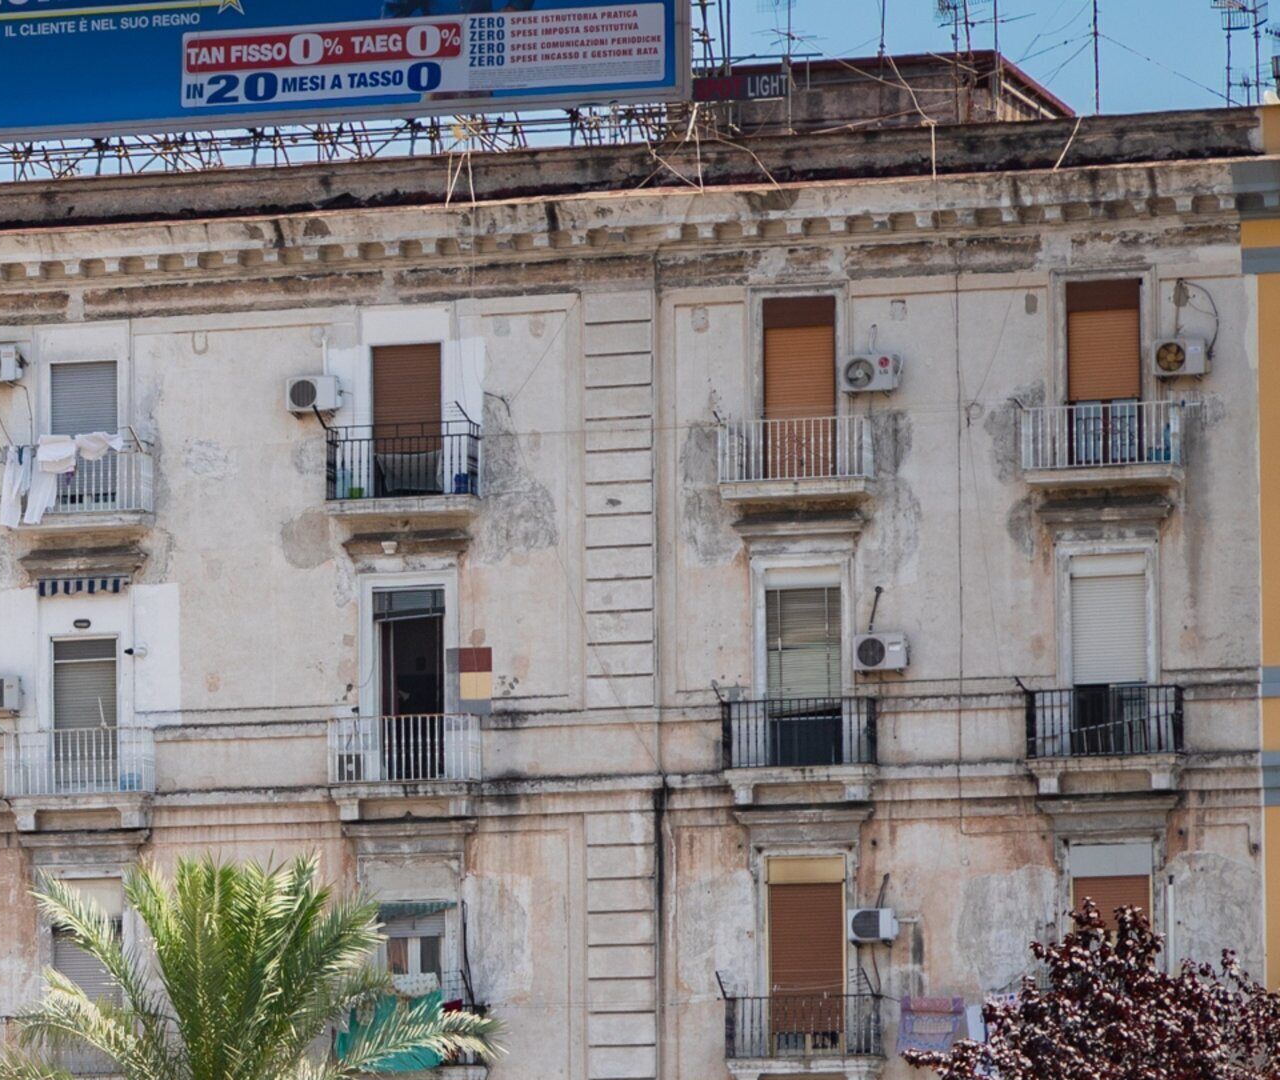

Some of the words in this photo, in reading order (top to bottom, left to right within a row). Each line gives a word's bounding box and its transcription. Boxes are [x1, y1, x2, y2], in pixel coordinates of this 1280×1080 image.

[5, 25, 17, 37] IL
[20, 21, 76, 36] CLIENTE
[79, 17, 88, 32] È
[91, 19, 117, 31] NEL
[120, 17, 149, 29] SUO
[152, 13, 200, 27] REGNO
[469, 17, 505, 29] ZERO
[510, 15, 538, 25] SPESE
[541, 12, 598, 23] ISTRUTTORIA
[600, 9, 638, 20] PRATICA
[469, 30, 505, 42] ZERO
[510, 28, 538, 38] SPESE
[541, 26, 580, 36] IMPOSTA
[583, 22, 639, 33] SOSTITUTIVA
[188, 46, 225, 66] TAN
[230, 42, 287, 63] FISSO
[289, 33, 343, 65] 0%
[351, 34, 402, 54] TAEG
[405, 24, 461, 57] 0%
[469, 42, 505, 55] ZERO
[510, 41, 538, 51] SPESE
[540, 38, 608, 49] COMUNICAZIONI
[611, 35, 661, 45] PERIODICHE
[469, 55, 505, 67] ZERO
[510, 54, 538, 64] SPESE
[541, 51, 580, 61] INCASSO
[582, 50, 588, 59] E
[591, 48, 633, 58] GESTIONE
[636, 46, 658, 56] RATA
[186, 83, 204, 99] IN
[206, 72, 278, 104] 20
[282, 74, 325, 93] MESI
[331, 73, 343, 89] A
[348, 69, 404, 88] TASSO
[406, 61, 442, 92] 0
[747, 75, 787, 97] LIGHT
